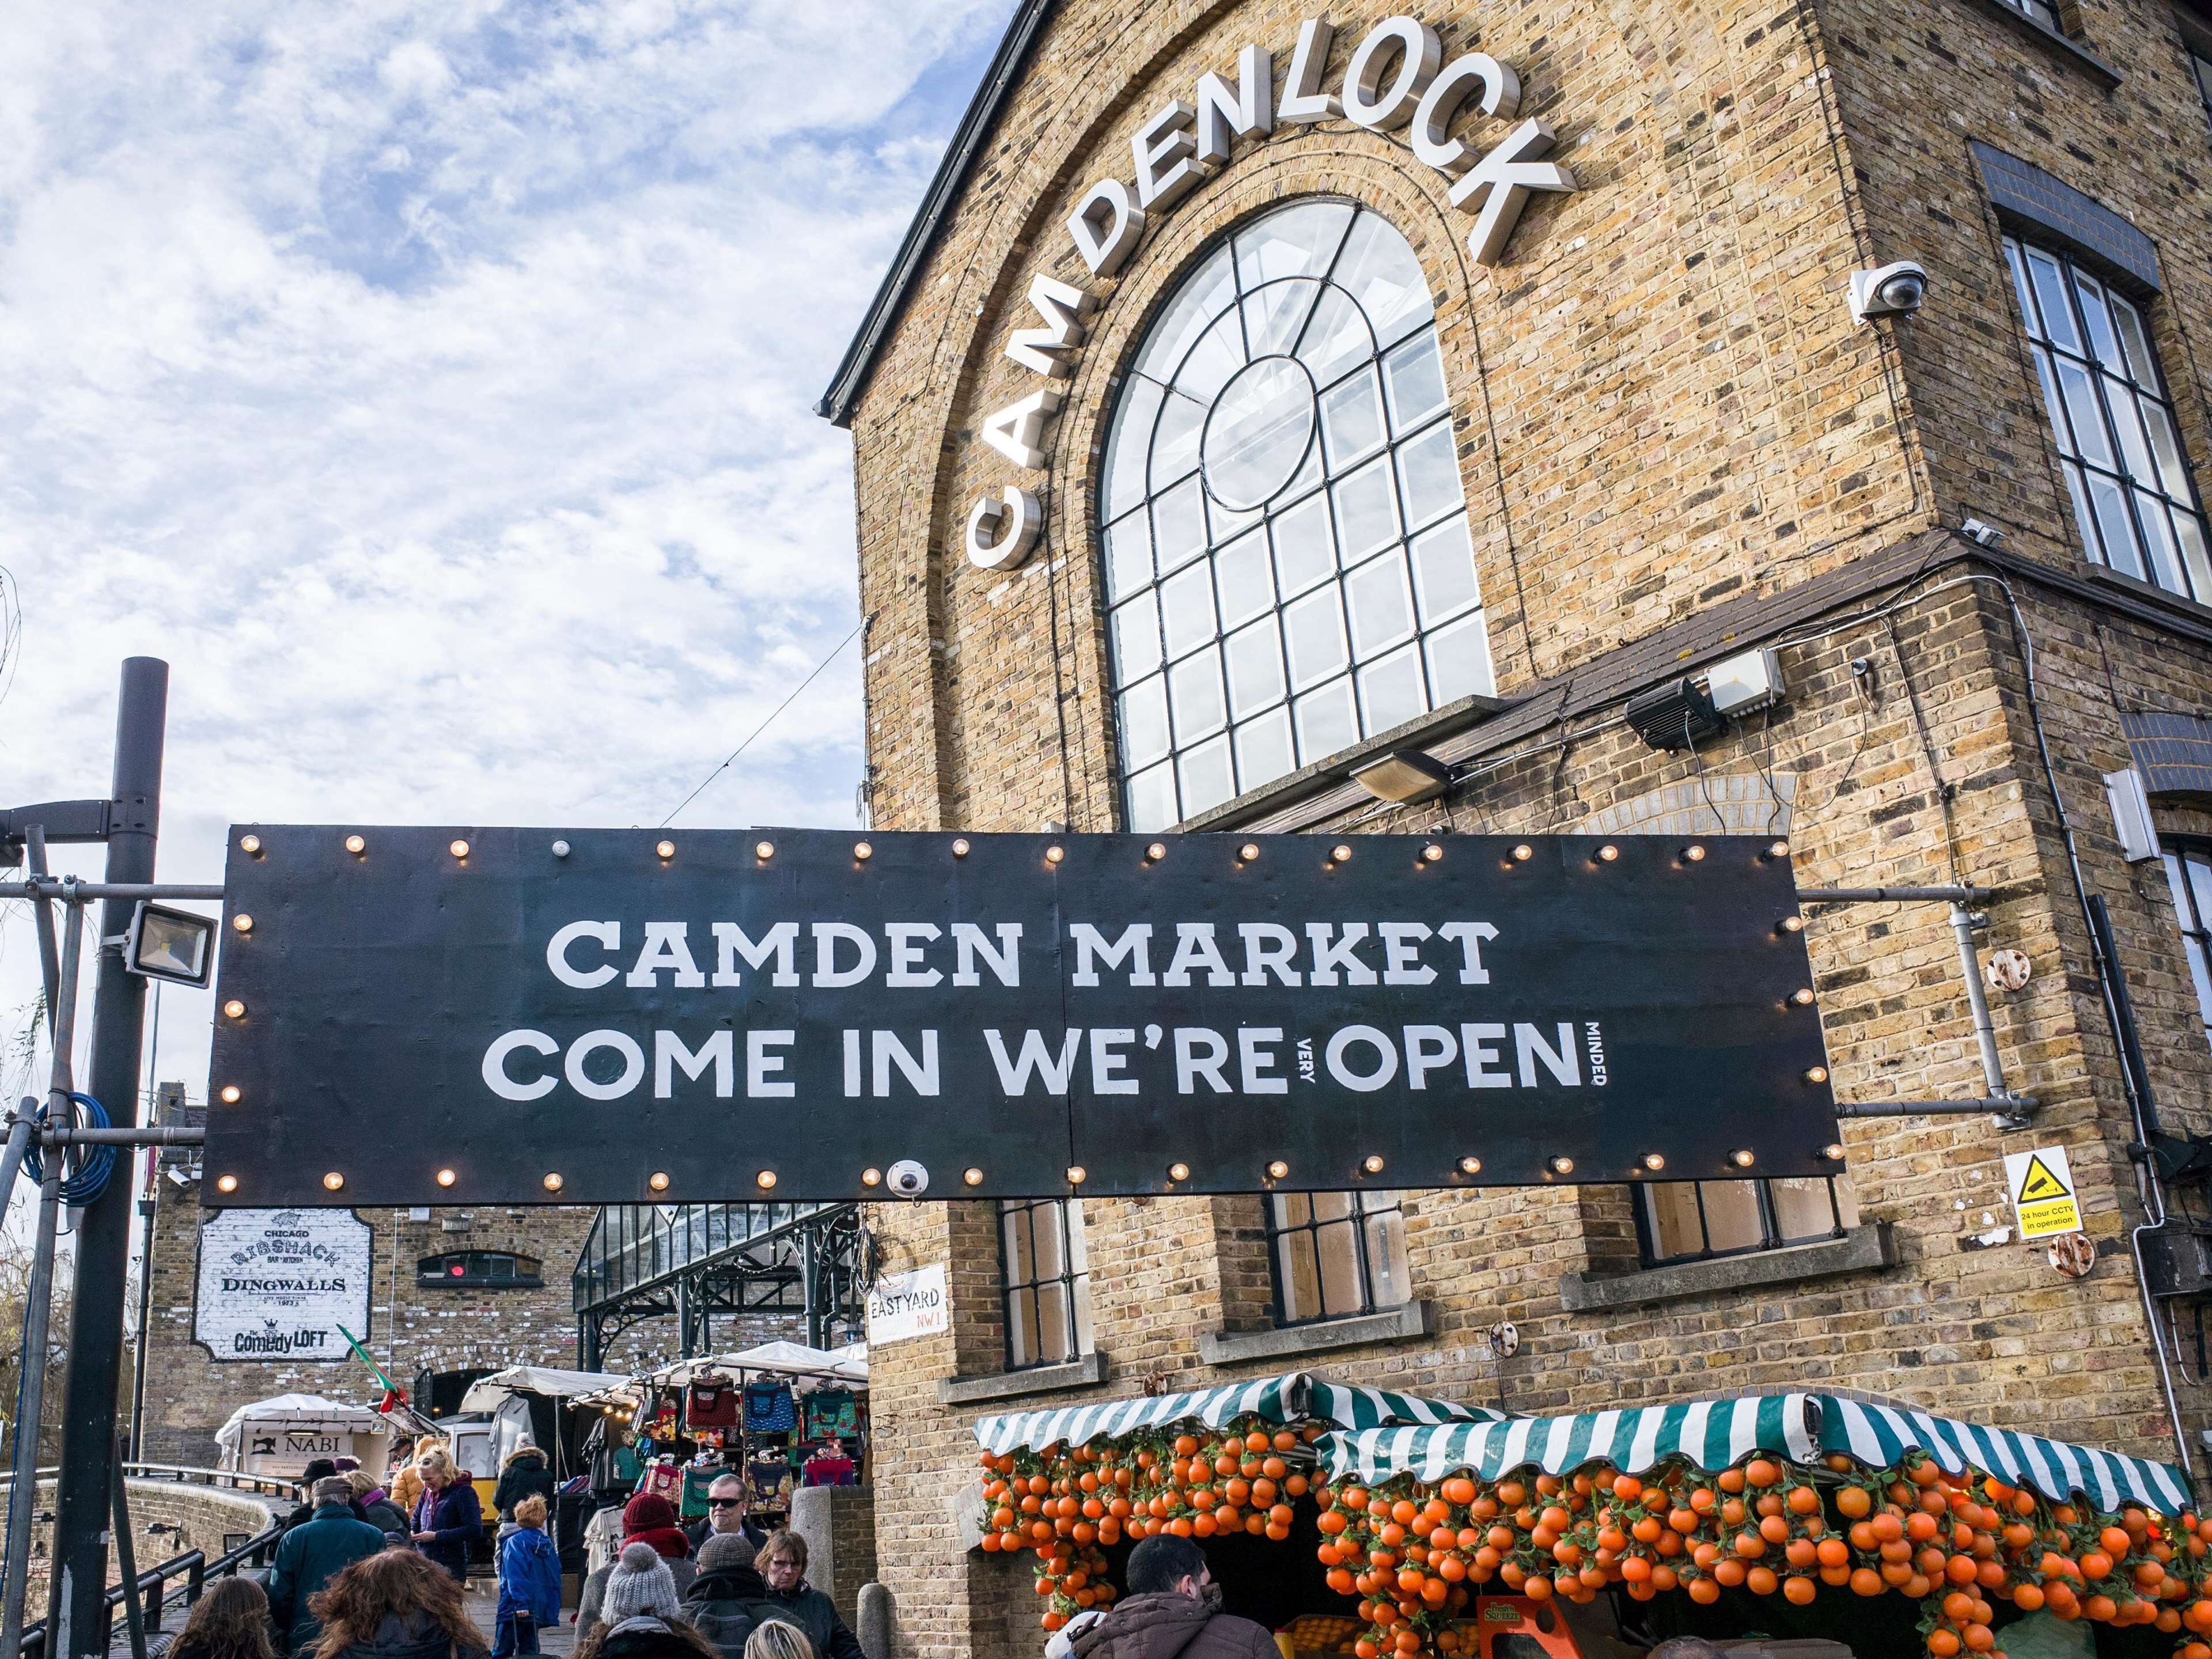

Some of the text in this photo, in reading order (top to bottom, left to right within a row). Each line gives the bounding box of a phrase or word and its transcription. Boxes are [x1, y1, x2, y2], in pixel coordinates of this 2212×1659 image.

[966, 15, 1579, 571] CAMDEN LOCK
[547, 920, 1500, 989] CAMDEN MARKET
[482, 1022, 1581, 1101] COME IN WE'RE OPEN
[1296, 1037, 1316, 1084] VERY
[1585, 1022, 1608, 1086] MINDED
[2032, 1210, 2050, 1218] hour
[2052, 1205, 2074, 1215] CCTV
[2036, 1217, 2073, 1229] operation
[230, 1240, 340, 1267] RIBSHACK
[222, 1278, 346, 1291] DINGWALLS
[234, 1330, 328, 1354] Comedy LOFT
[285, 1437, 340, 1452] NABI
